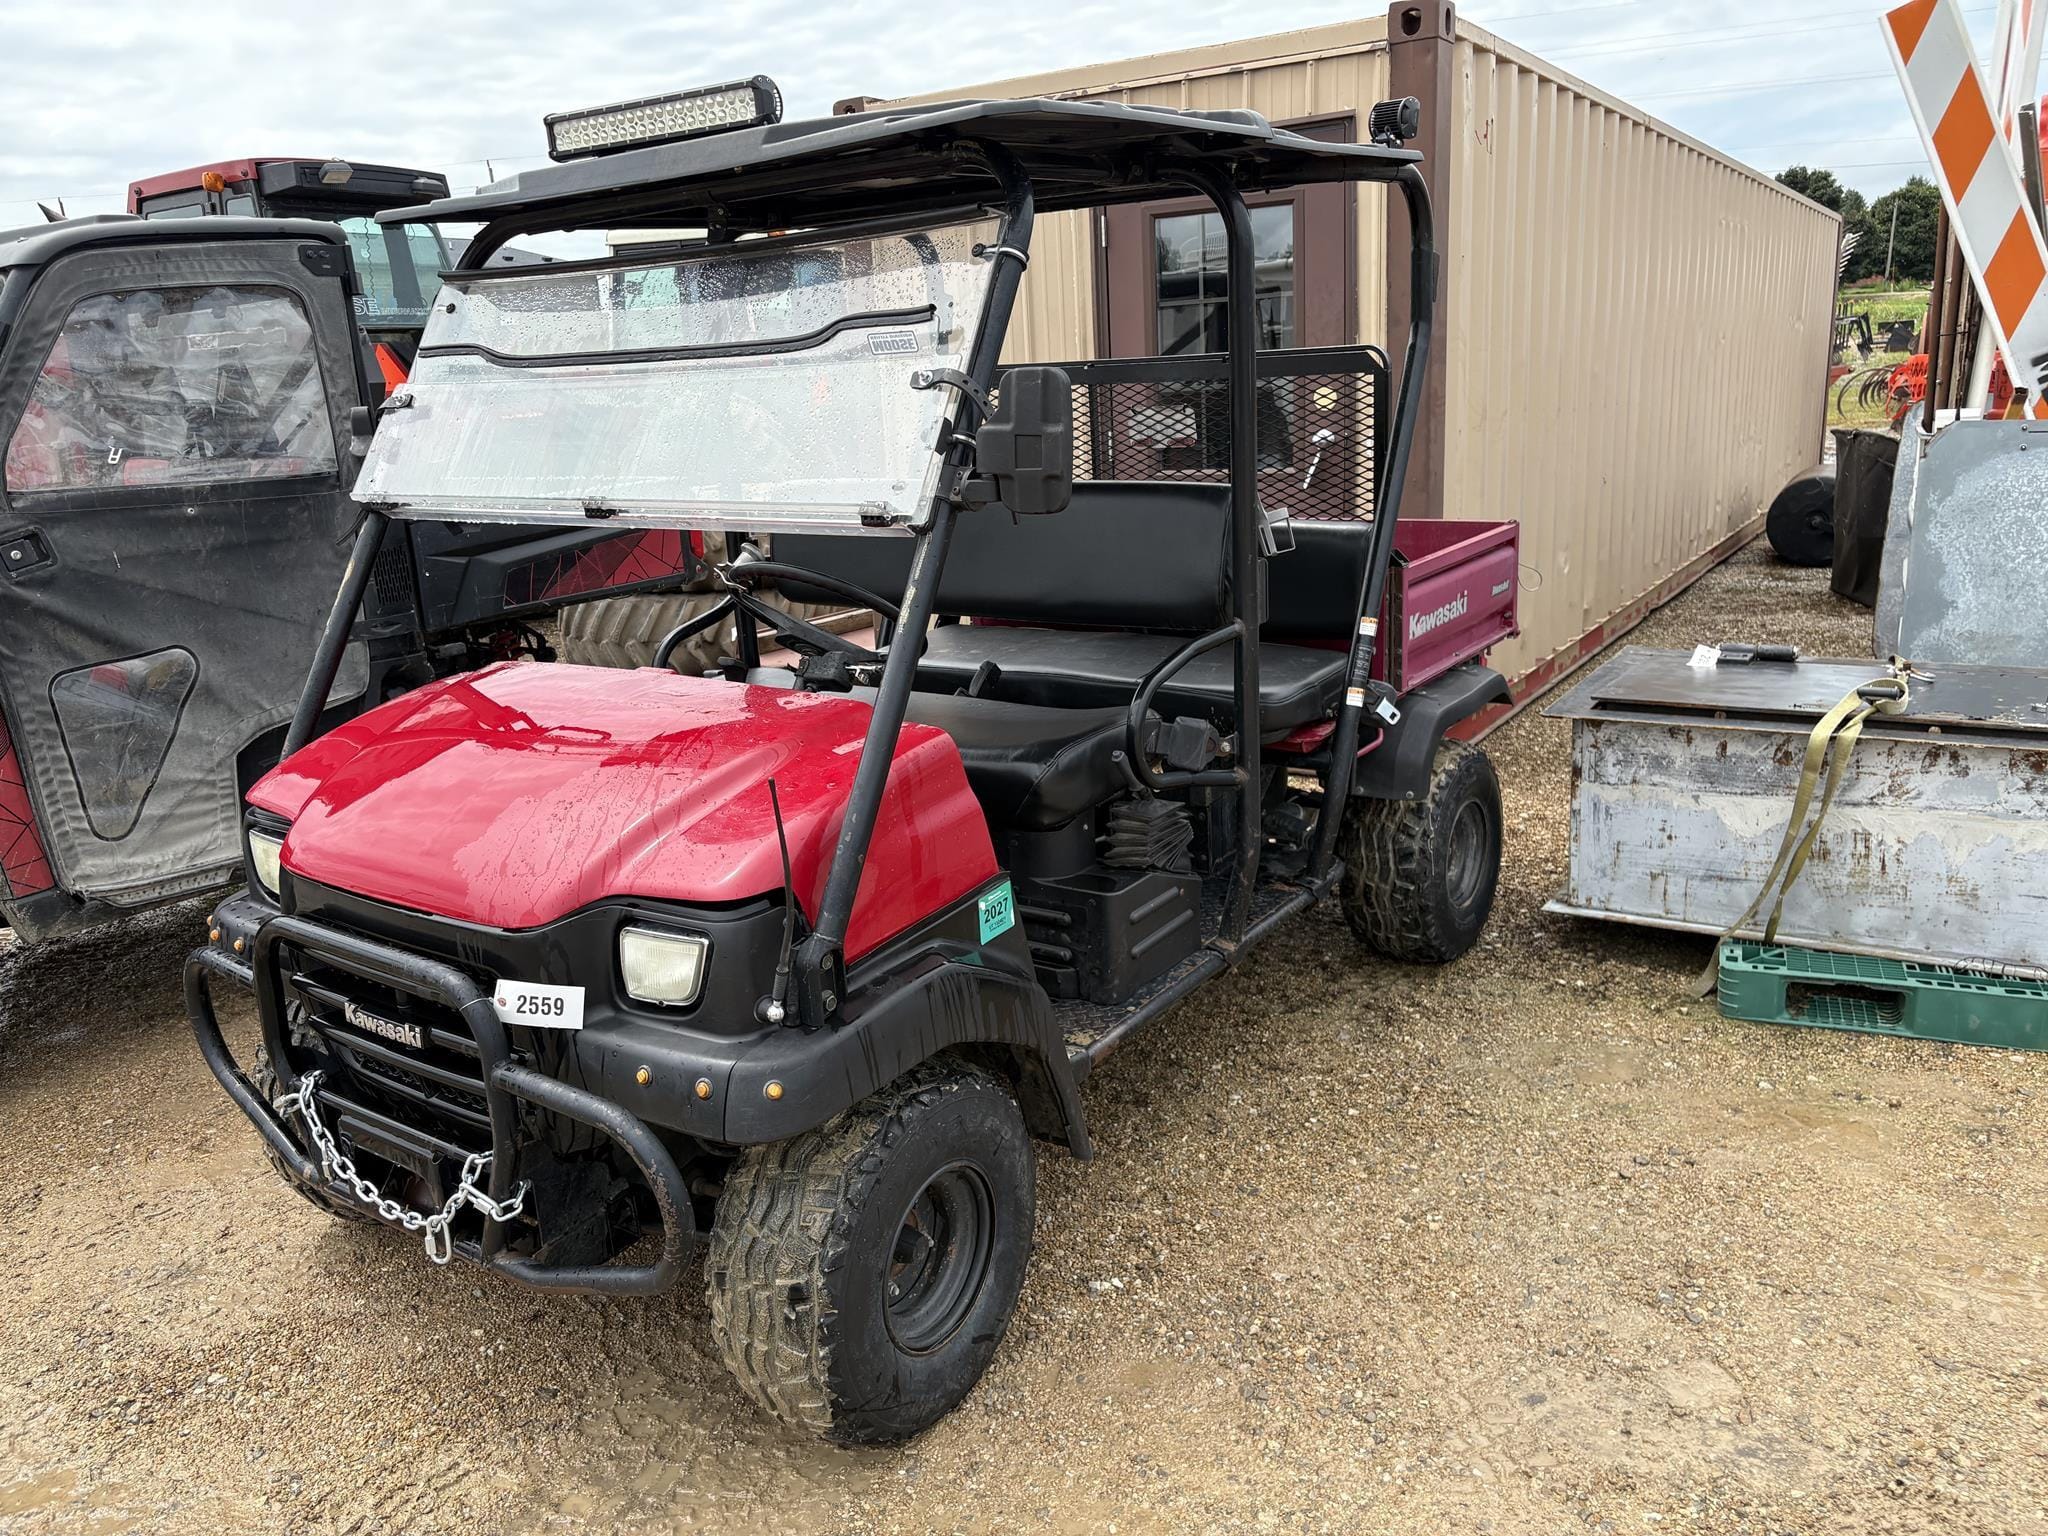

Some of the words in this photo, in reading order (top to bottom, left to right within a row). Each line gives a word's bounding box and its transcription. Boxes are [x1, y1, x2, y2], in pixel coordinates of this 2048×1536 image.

[1409, 590, 1468, 640] Kawasaki
[984, 896, 1008, 924] 2027
[516, 994, 564, 1016] 2559
[344, 1002, 422, 1049] Kawasaki
